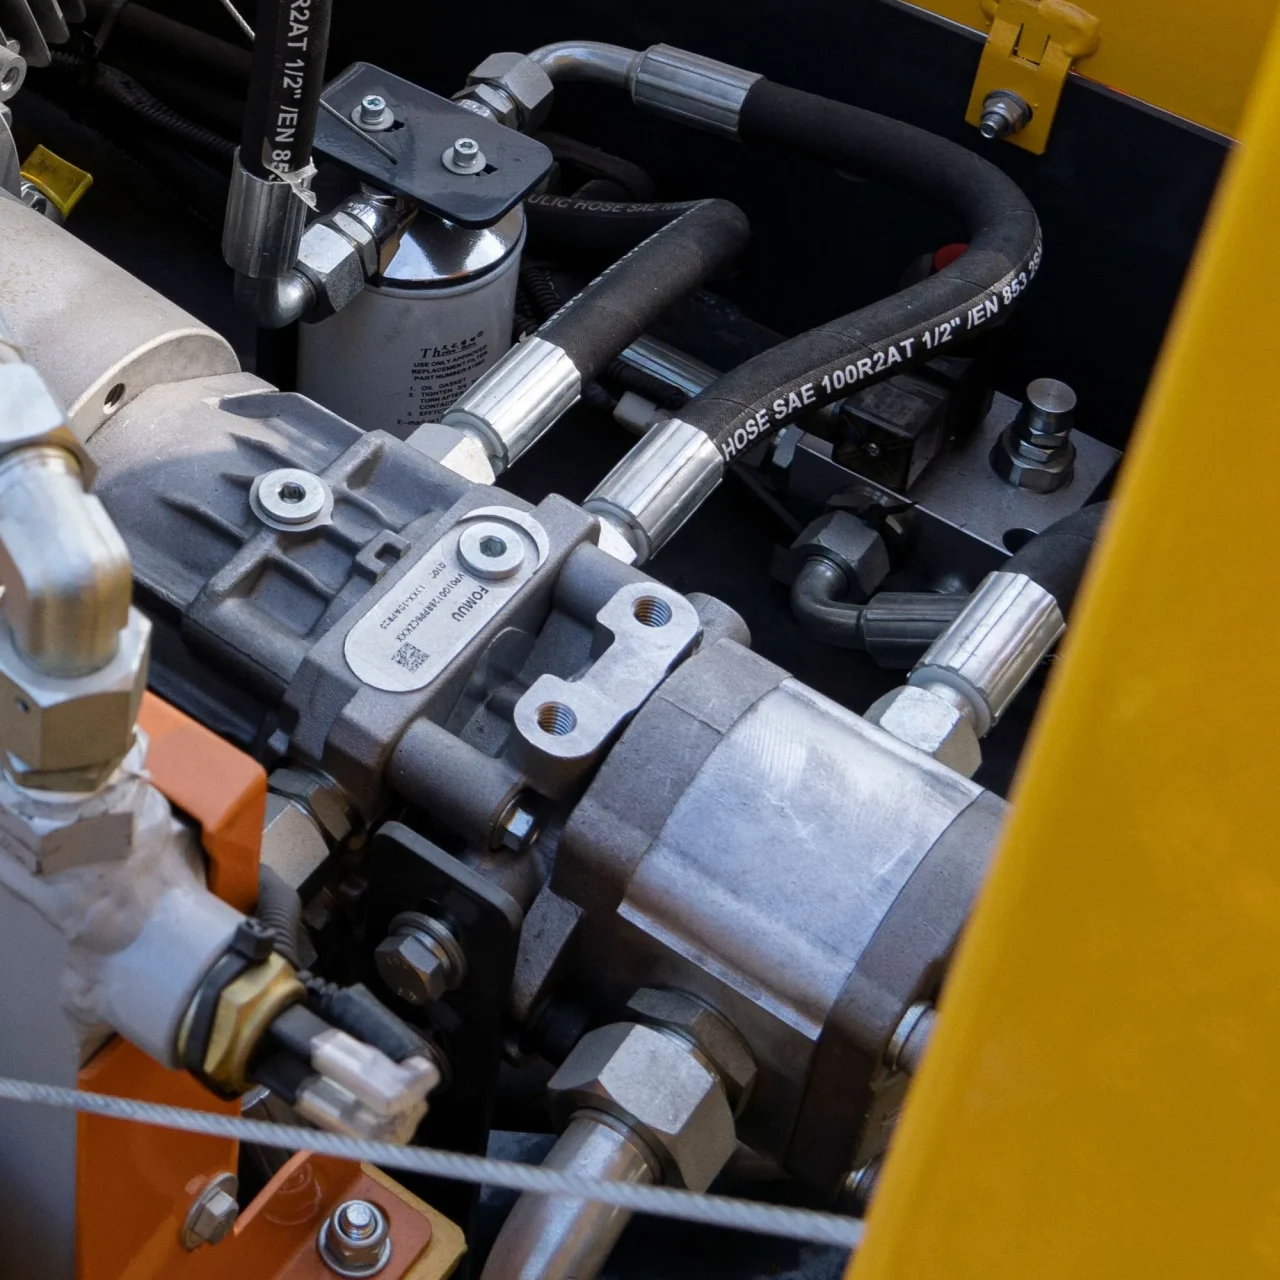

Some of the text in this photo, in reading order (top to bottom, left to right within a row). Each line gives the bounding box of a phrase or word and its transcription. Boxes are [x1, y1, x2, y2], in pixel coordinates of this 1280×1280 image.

[282, 58, 305, 99] 1/2"
[274, 105, 299, 143] /EN
[574, 199, 624, 213] HOSE
[431, 358, 451, 367] ONLY
[721, 409, 770, 462] HOSE
[773, 382, 816, 419] SAE
[821, 337, 915, 394] 100R2AT
[922, 317, 961, 350] 1/2"
[967, 295, 998, 330] /EN
[1002, 272, 1027, 305] 853
[452, 585, 489, 622] FOMUU
